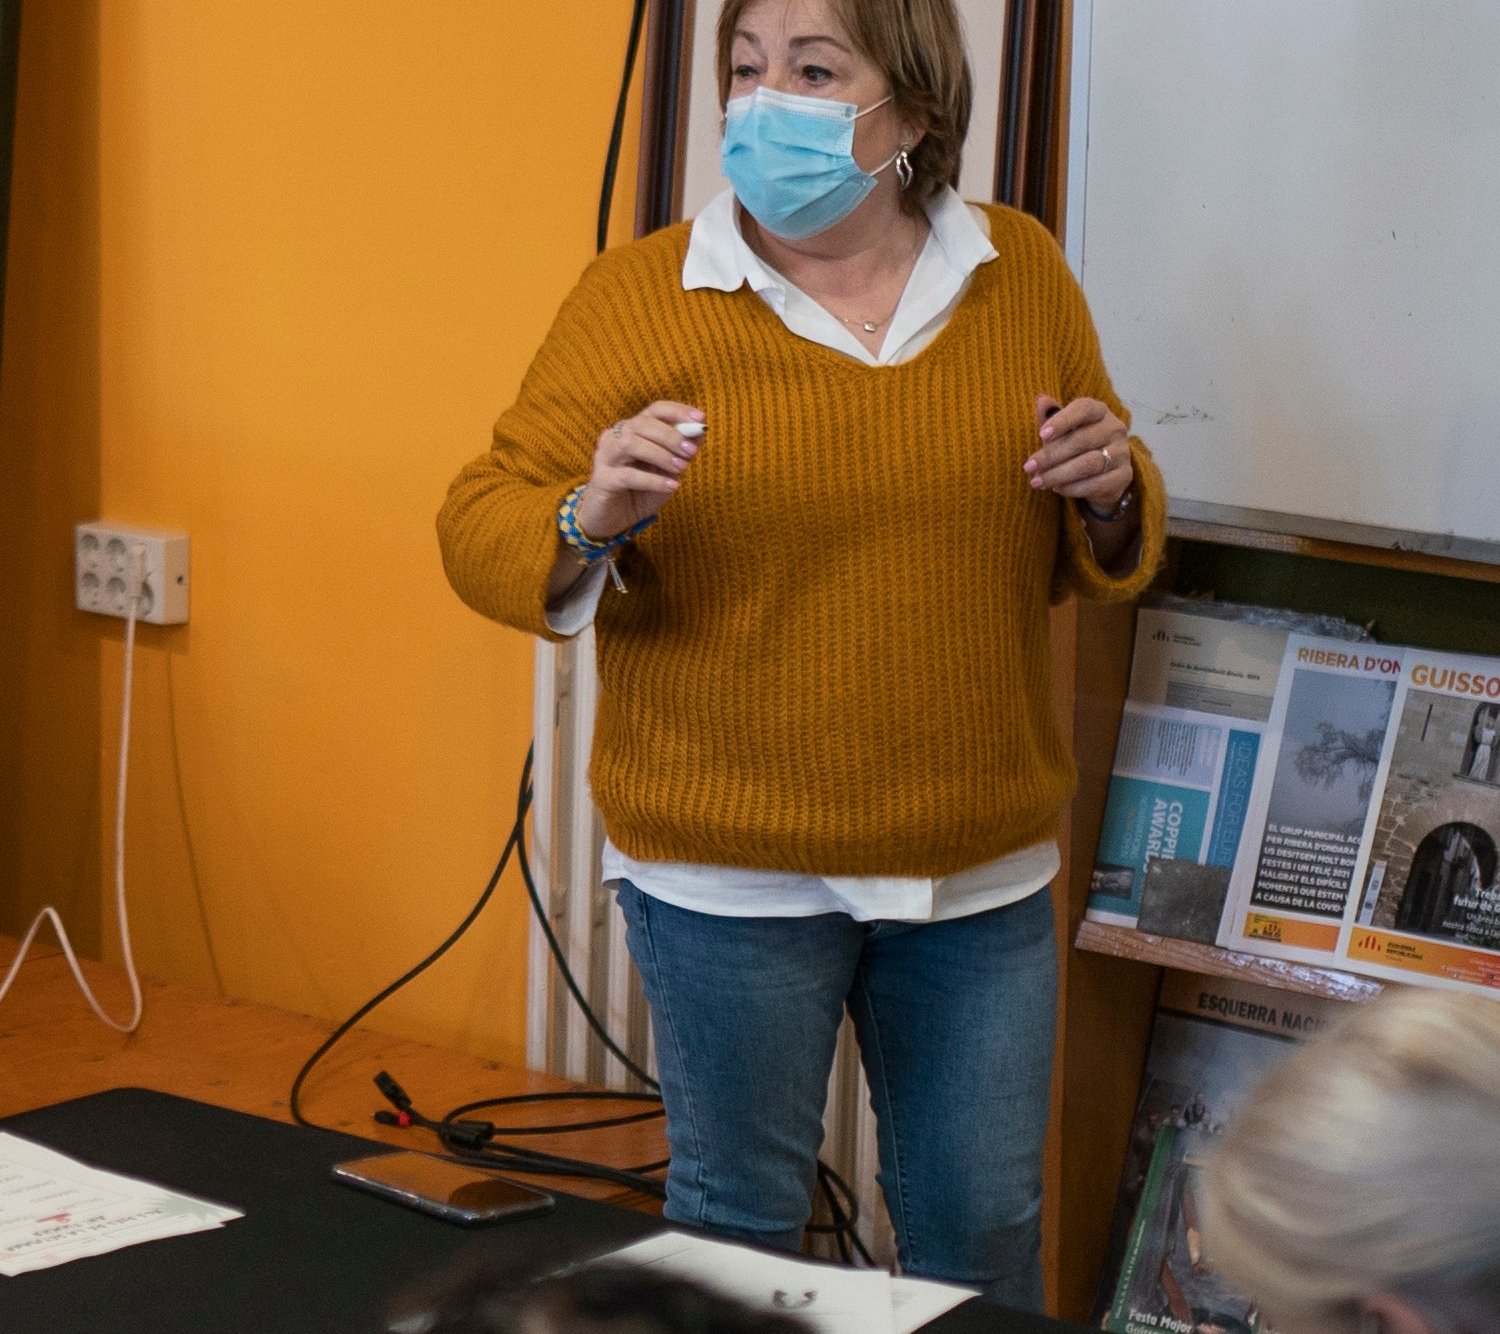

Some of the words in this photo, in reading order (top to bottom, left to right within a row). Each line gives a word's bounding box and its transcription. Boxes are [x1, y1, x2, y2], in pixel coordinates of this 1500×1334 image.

[1297, 647, 1360, 670] RIBERA
[1198, 992, 1277, 1025] ESQUERRA
[1128, 1309, 1157, 1326] Festa
[1159, 1317, 1193, 1334] Major
